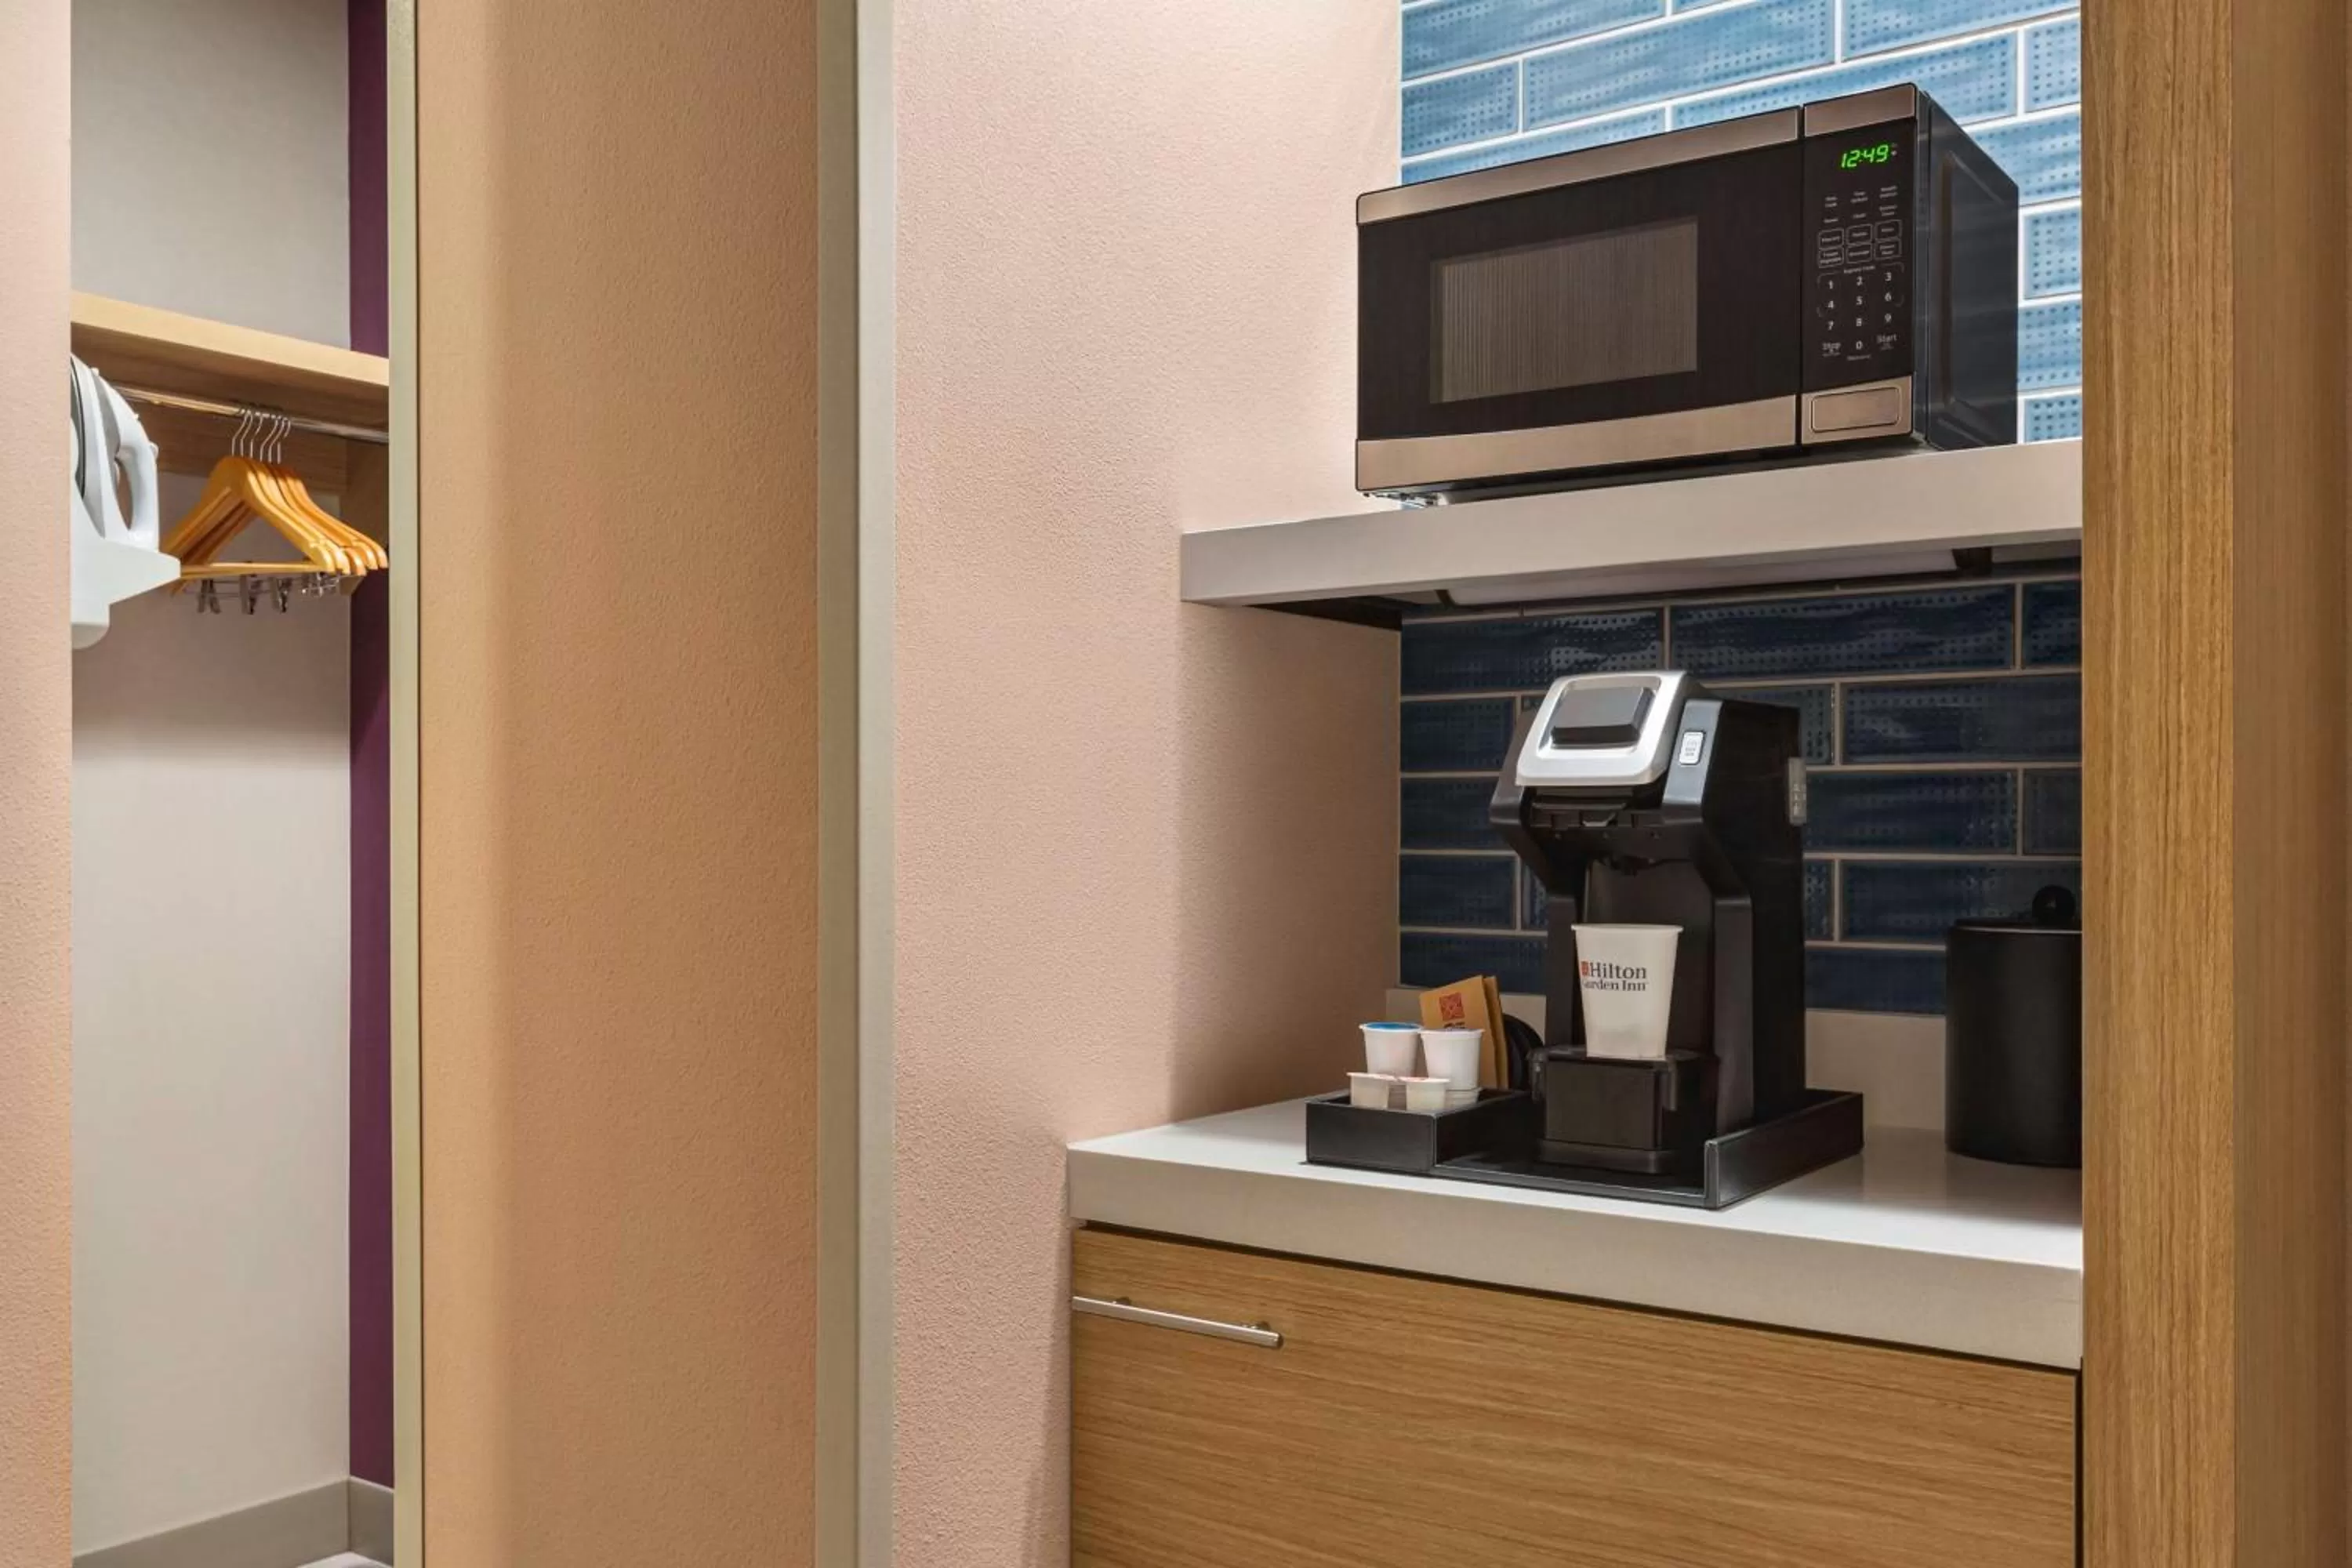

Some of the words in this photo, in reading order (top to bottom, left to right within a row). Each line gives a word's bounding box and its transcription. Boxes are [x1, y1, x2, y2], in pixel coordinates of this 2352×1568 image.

[1841, 144, 1889, 168] 12:49
[1856, 275, 1863, 286] 2
[1884, 271, 1892, 281] 3
[1828, 300, 1834, 309] 4
[1856, 296, 1863, 305] 5
[1884, 292, 1892, 301] 6
[1828, 321, 1834, 330] 7
[1856, 318, 1862, 327] 8
[1884, 313, 1892, 323] 9
[1856, 340, 1863, 350] 0
[1590, 961, 1646, 979] Hilton
[1621, 980, 1646, 992] Inn
